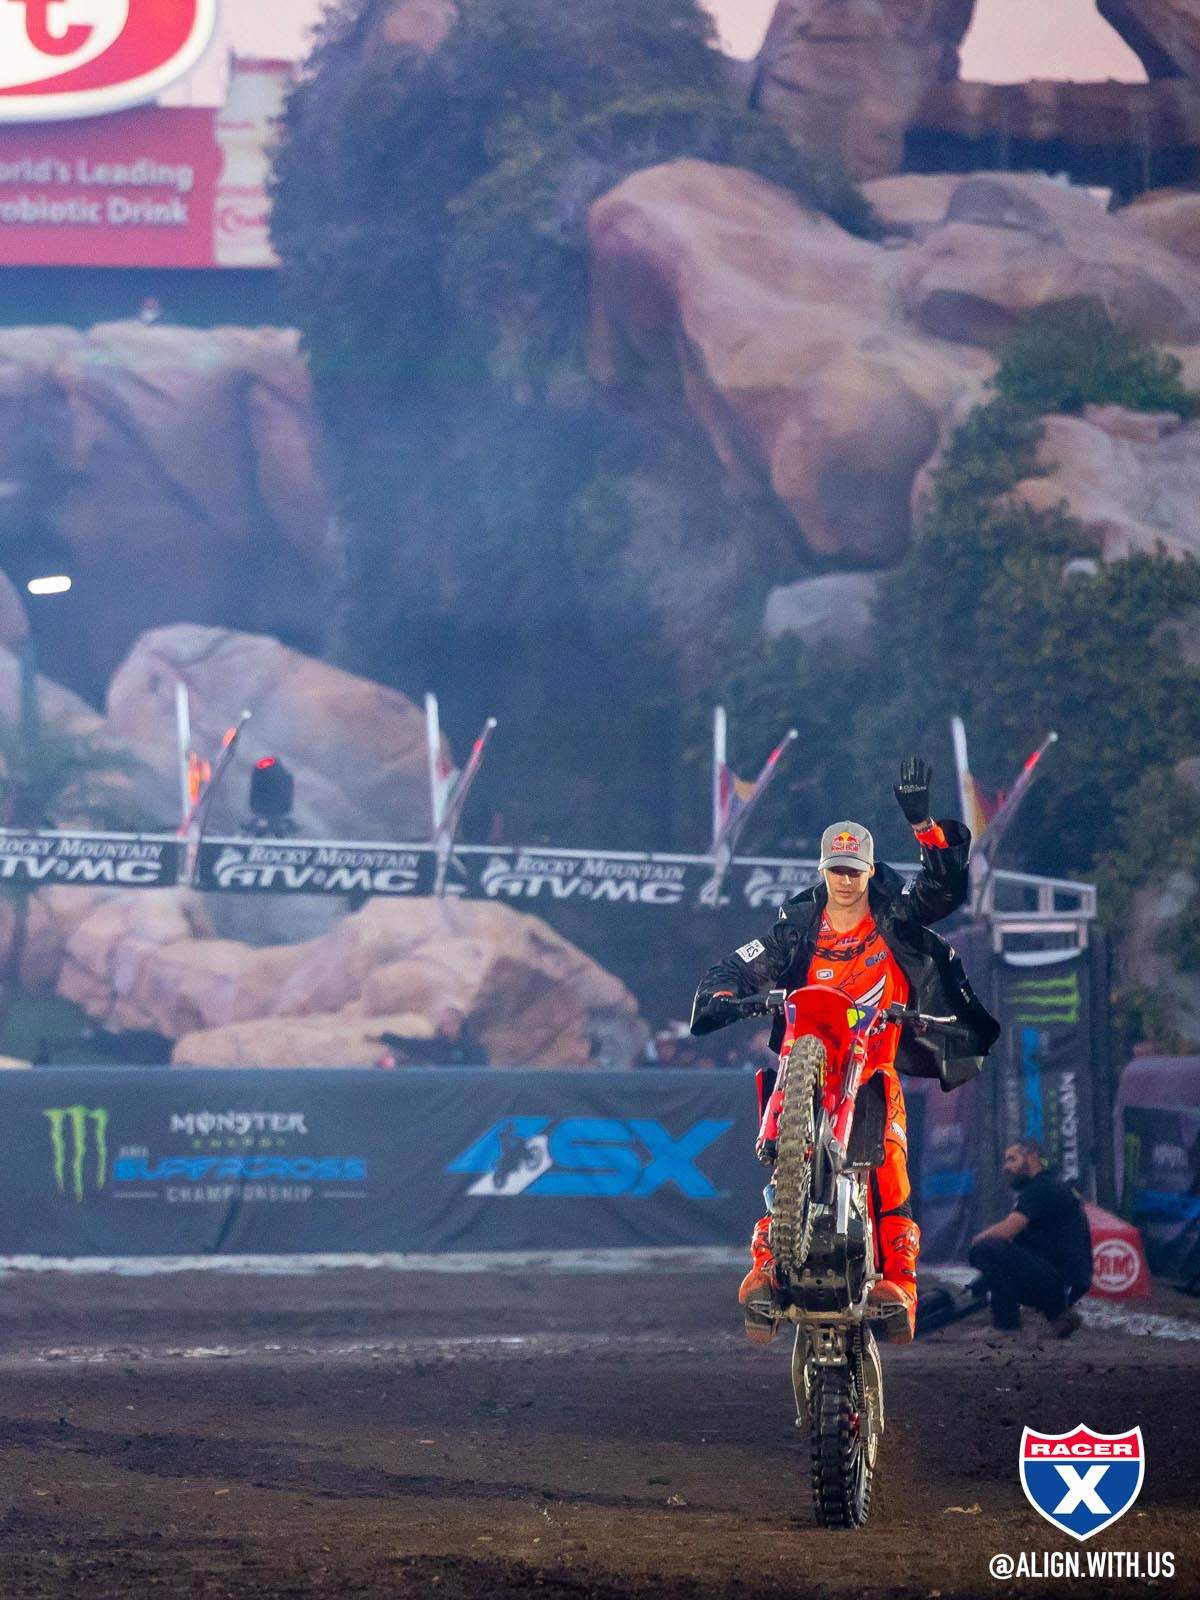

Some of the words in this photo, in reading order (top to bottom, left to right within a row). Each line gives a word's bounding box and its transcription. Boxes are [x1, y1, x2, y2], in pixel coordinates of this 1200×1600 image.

[77, 159, 194, 192] Leading
[106, 196, 189, 224] Drink
[169, 1110, 309, 1135] MONSTER
